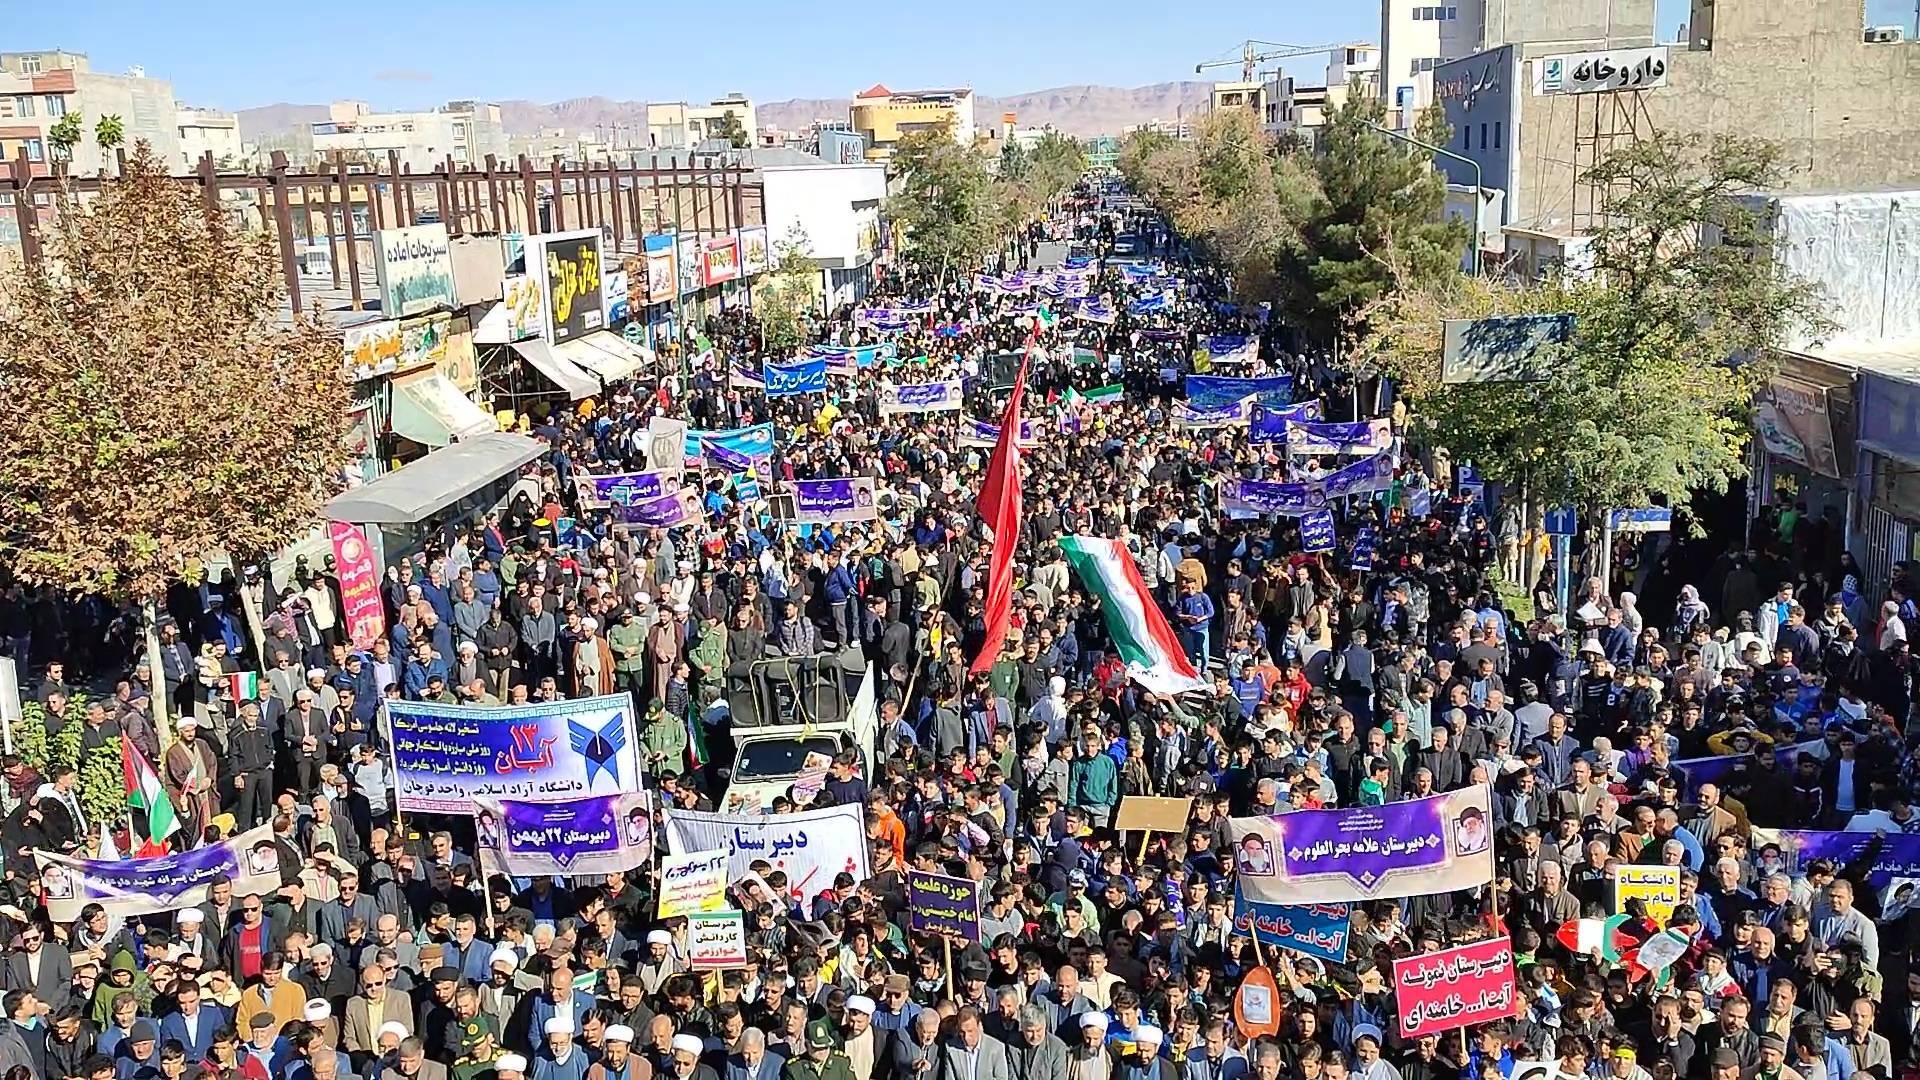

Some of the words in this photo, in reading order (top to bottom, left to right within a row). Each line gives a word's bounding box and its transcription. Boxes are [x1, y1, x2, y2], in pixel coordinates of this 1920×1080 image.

[1573, 57, 1665, 86] داروخانه
[387, 232, 410, 262] آماده
[411, 236, 447, 263] سبزیجات
[1459, 466, 1472, 483] P
[457, 722, 480, 736] تسخیر
[510, 723, 539, 753] ۱۳
[494, 735, 558, 775] آبان
[473, 761, 487, 776] روز
[403, 780, 435, 797] قوچان
[438, 784, 465, 798] واحد
[509, 781, 534, 798] آزاد
[539, 779, 583, 793] دانشگاه
[511, 829, 548, 847] بهمن
[564, 826, 611, 846] دبیرستان
[1352, 836, 1379, 853] علامه
[1382, 835, 1425, 855] دبیرستان
[912, 877, 941, 893] علمیه
[1620, 872, 1675, 885] دانشگاه
[942, 883, 971, 901] حوزه
[1652, 891, 1675, 906] پیام
[921, 903, 957, 920] خمینی
[957, 909, 977, 923] امام
[694, 920, 737, 930] هنرستان
[1256, 915, 1295, 937] خامنه
[1314, 930, 1345, 954] آیت
[696, 946, 738, 957] خوارزمی
[1403, 961, 1446, 988] نمونه
[1447, 950, 1511, 983] دبیرستان
[1487, 983, 1512, 1009] آیت
[1404, 1002, 1424, 1030] ای
[1426, 995, 1465, 1019] خامنه
